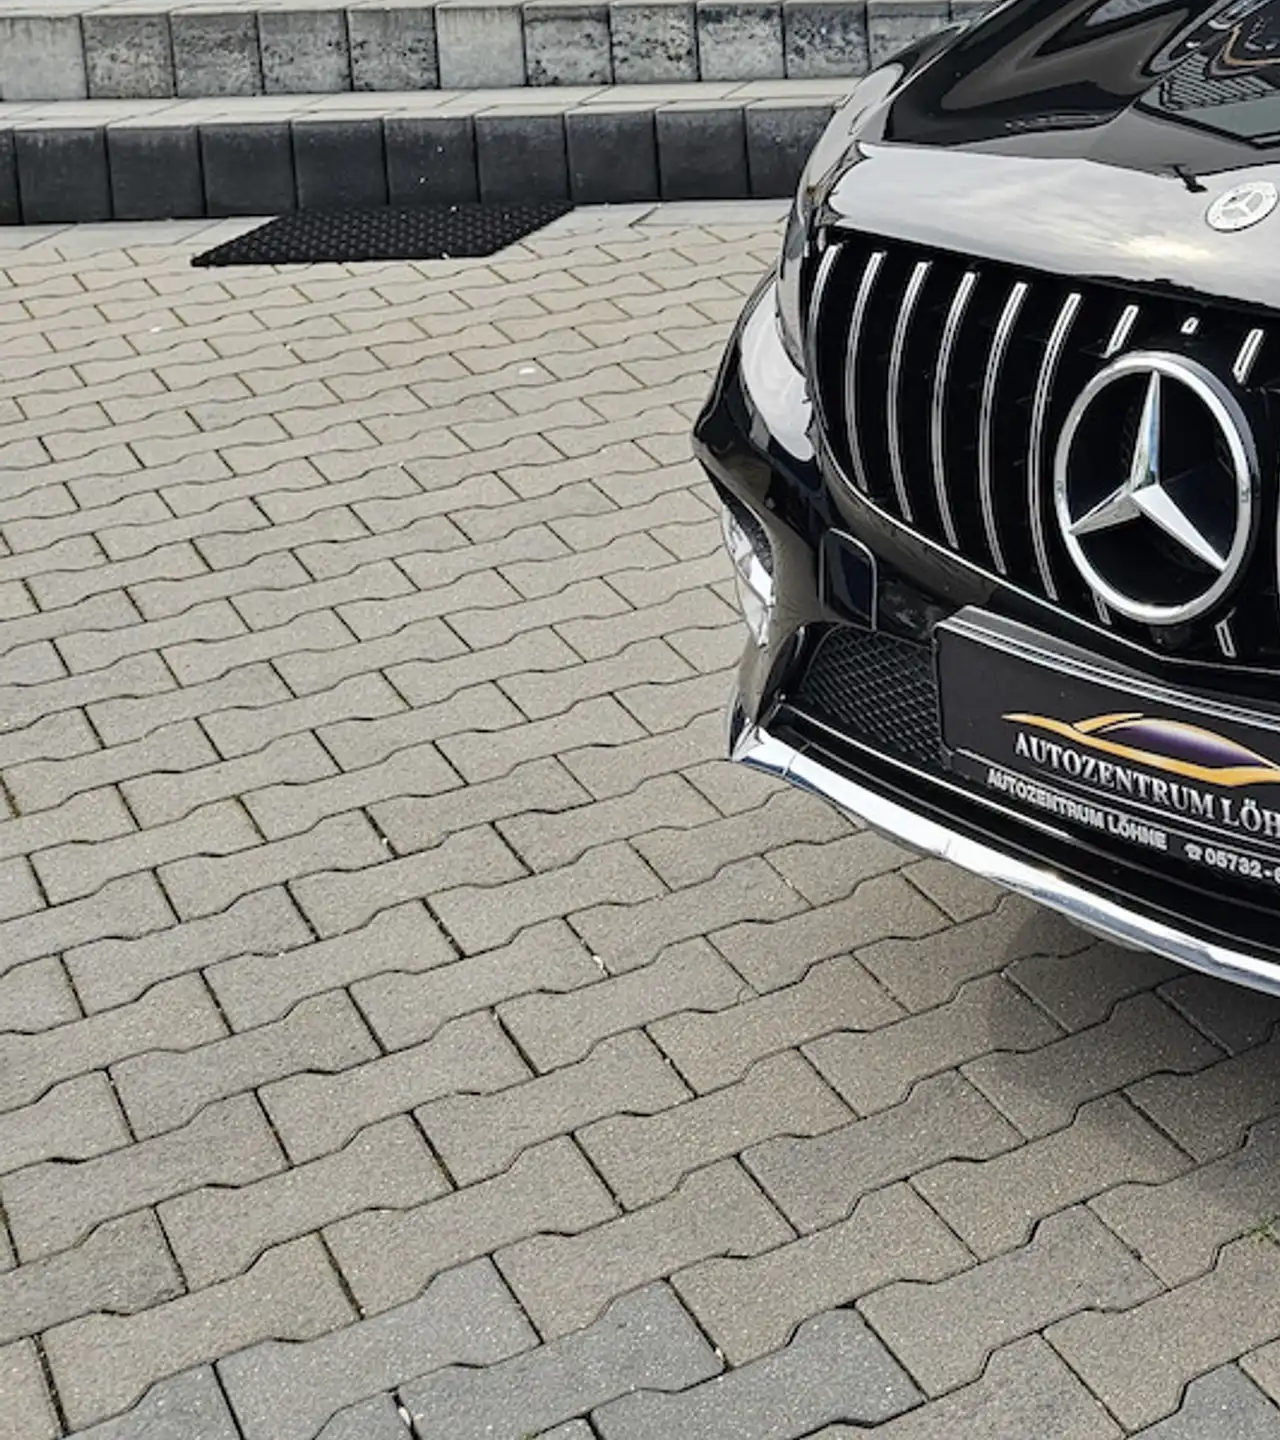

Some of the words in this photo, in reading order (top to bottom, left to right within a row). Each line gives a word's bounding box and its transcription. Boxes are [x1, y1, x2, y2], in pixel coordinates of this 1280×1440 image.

[987, 767, 1105, 830] AUTOZENTRUM
[1107, 813, 1169, 851] LÖHNE
[1013, 731, 1215, 819] AUTOZENTRUM
